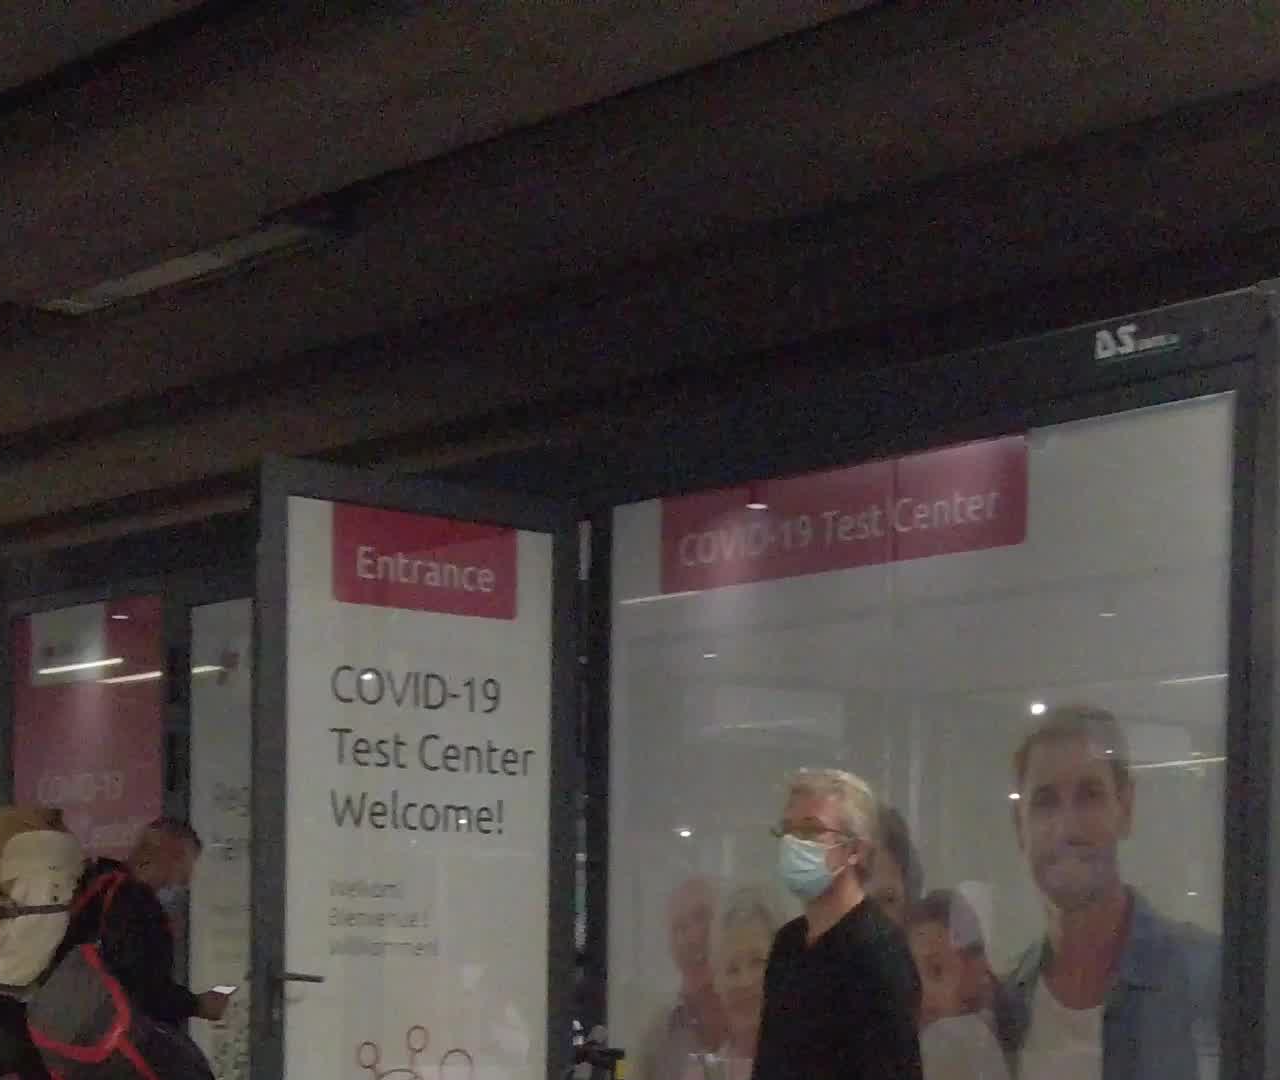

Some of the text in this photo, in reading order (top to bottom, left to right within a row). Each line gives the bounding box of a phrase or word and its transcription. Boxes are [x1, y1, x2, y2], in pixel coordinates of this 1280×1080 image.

[679, 488, 1001, 567] COVID-19 Test Center
[355, 545, 497, 593] Entrance
[330, 664, 502, 713] COVID-19
[330, 727, 536, 777] Test Center
[329, 788, 505, 835] Welcome!
